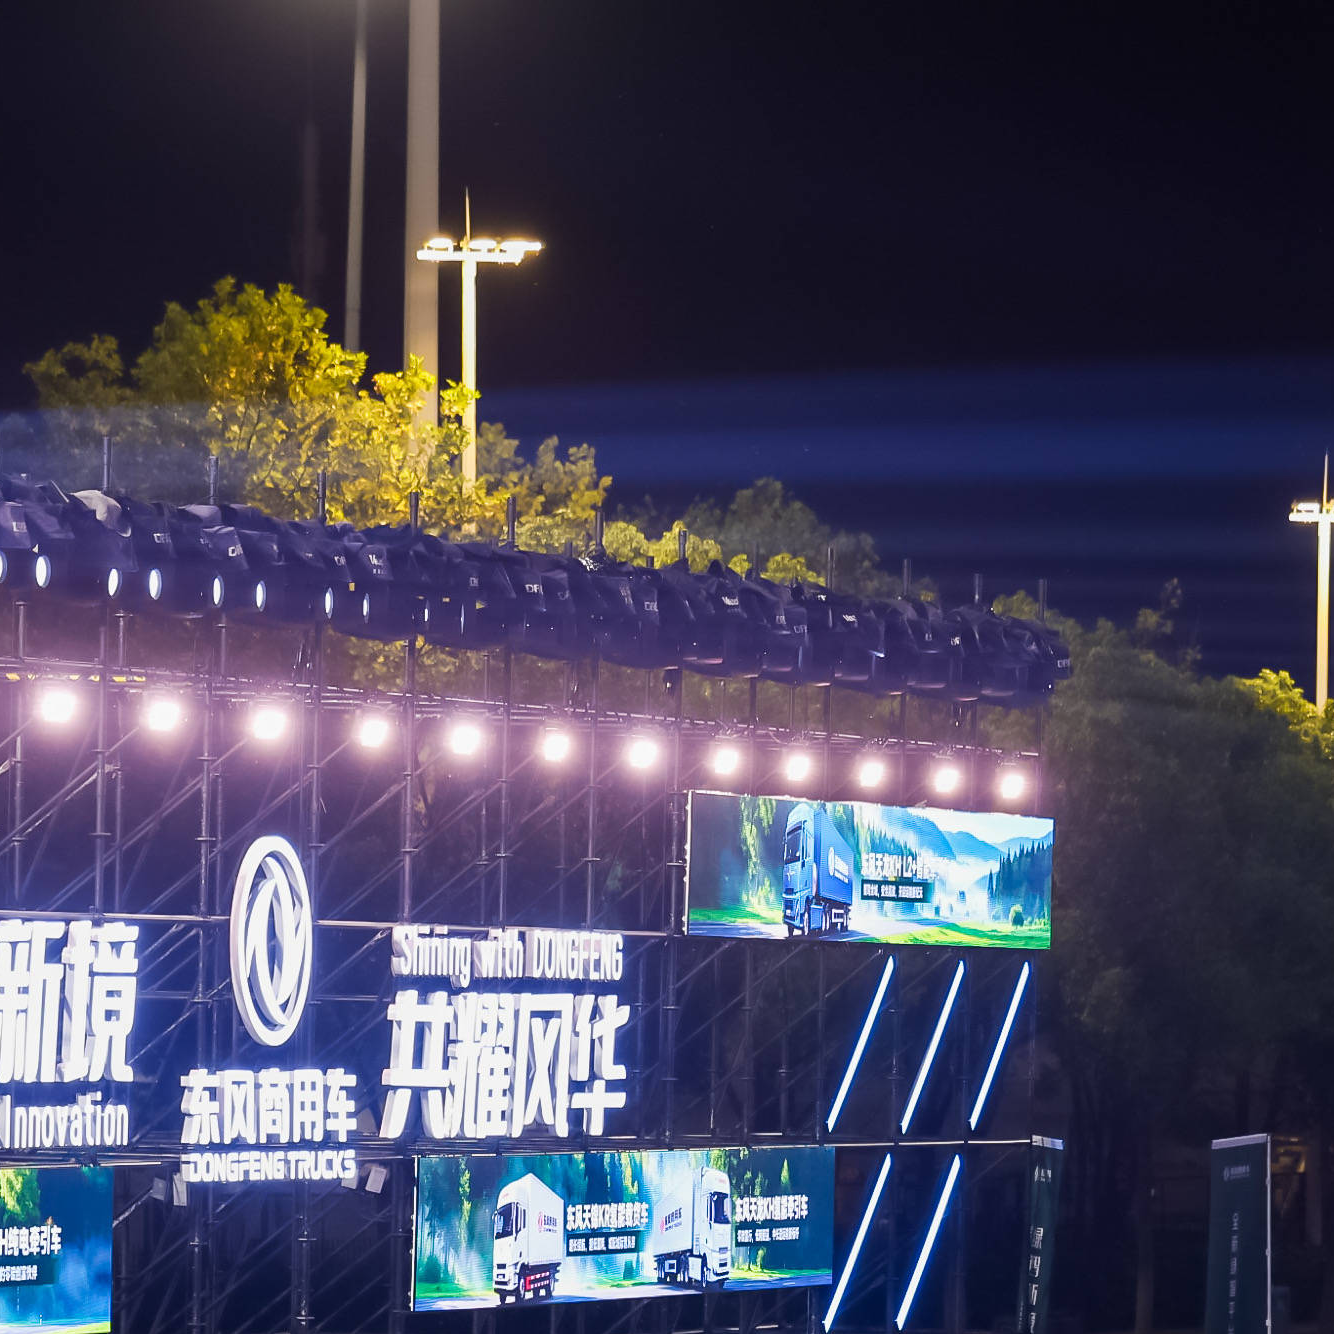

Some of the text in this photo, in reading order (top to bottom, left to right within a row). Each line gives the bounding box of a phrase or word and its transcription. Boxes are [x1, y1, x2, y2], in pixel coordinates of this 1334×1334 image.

[392, 925, 624, 988] Shining with DONGFENG
[379, 990, 630, 1138] 共耀风华
[180, 1067, 357, 1144] 东风商用车
[181, 1149, 356, 1182] DONGFENG TRUCKS
